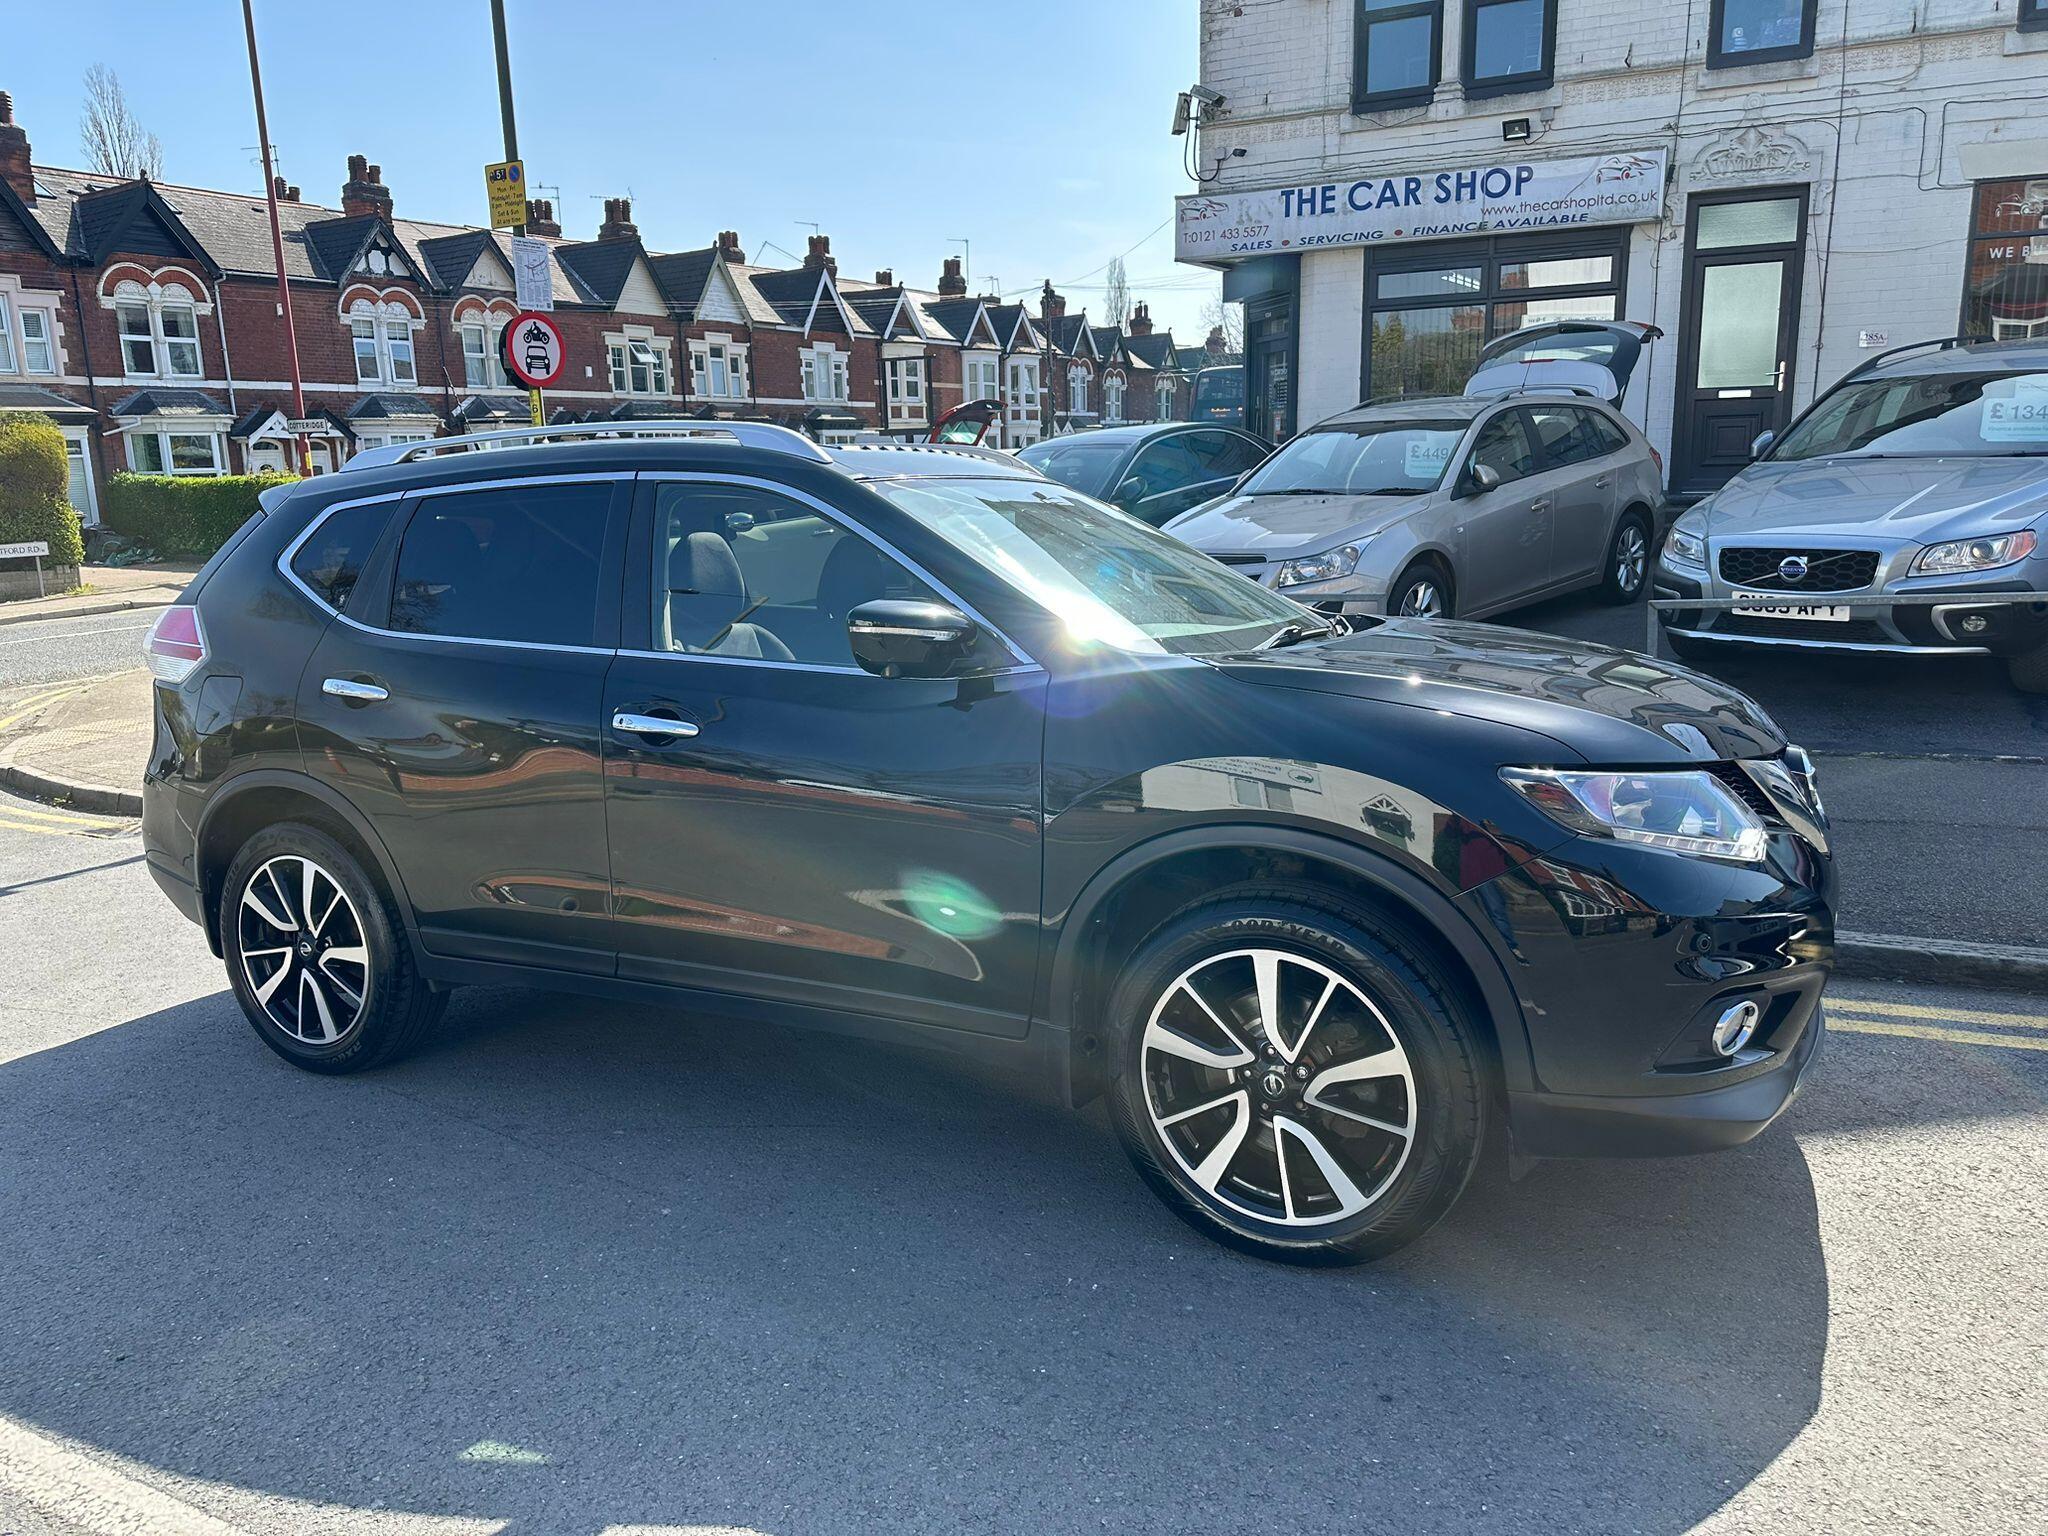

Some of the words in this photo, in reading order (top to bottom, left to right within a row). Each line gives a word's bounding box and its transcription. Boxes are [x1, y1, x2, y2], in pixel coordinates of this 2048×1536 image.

[1281, 185, 1336, 218] THE
[1348, 176, 1422, 211] CAR
[1433, 166, 1533, 204] SHOP
[1481, 189, 1658, 216] www.thecarshopltd.co.uk
[1184, 229, 1215, 244] T:0121
[1220, 227, 1240, 240] 433
[1244, 225, 1270, 238] 5577
[1230, 240, 1273, 252] SALES
[1299, 229, 1384, 246] SERVICING
[1413, 220, 1488, 236] FINANCE
[1493, 212, 1589, 229] AVAILABLE
[1989, 246, 2014, 259] WE
